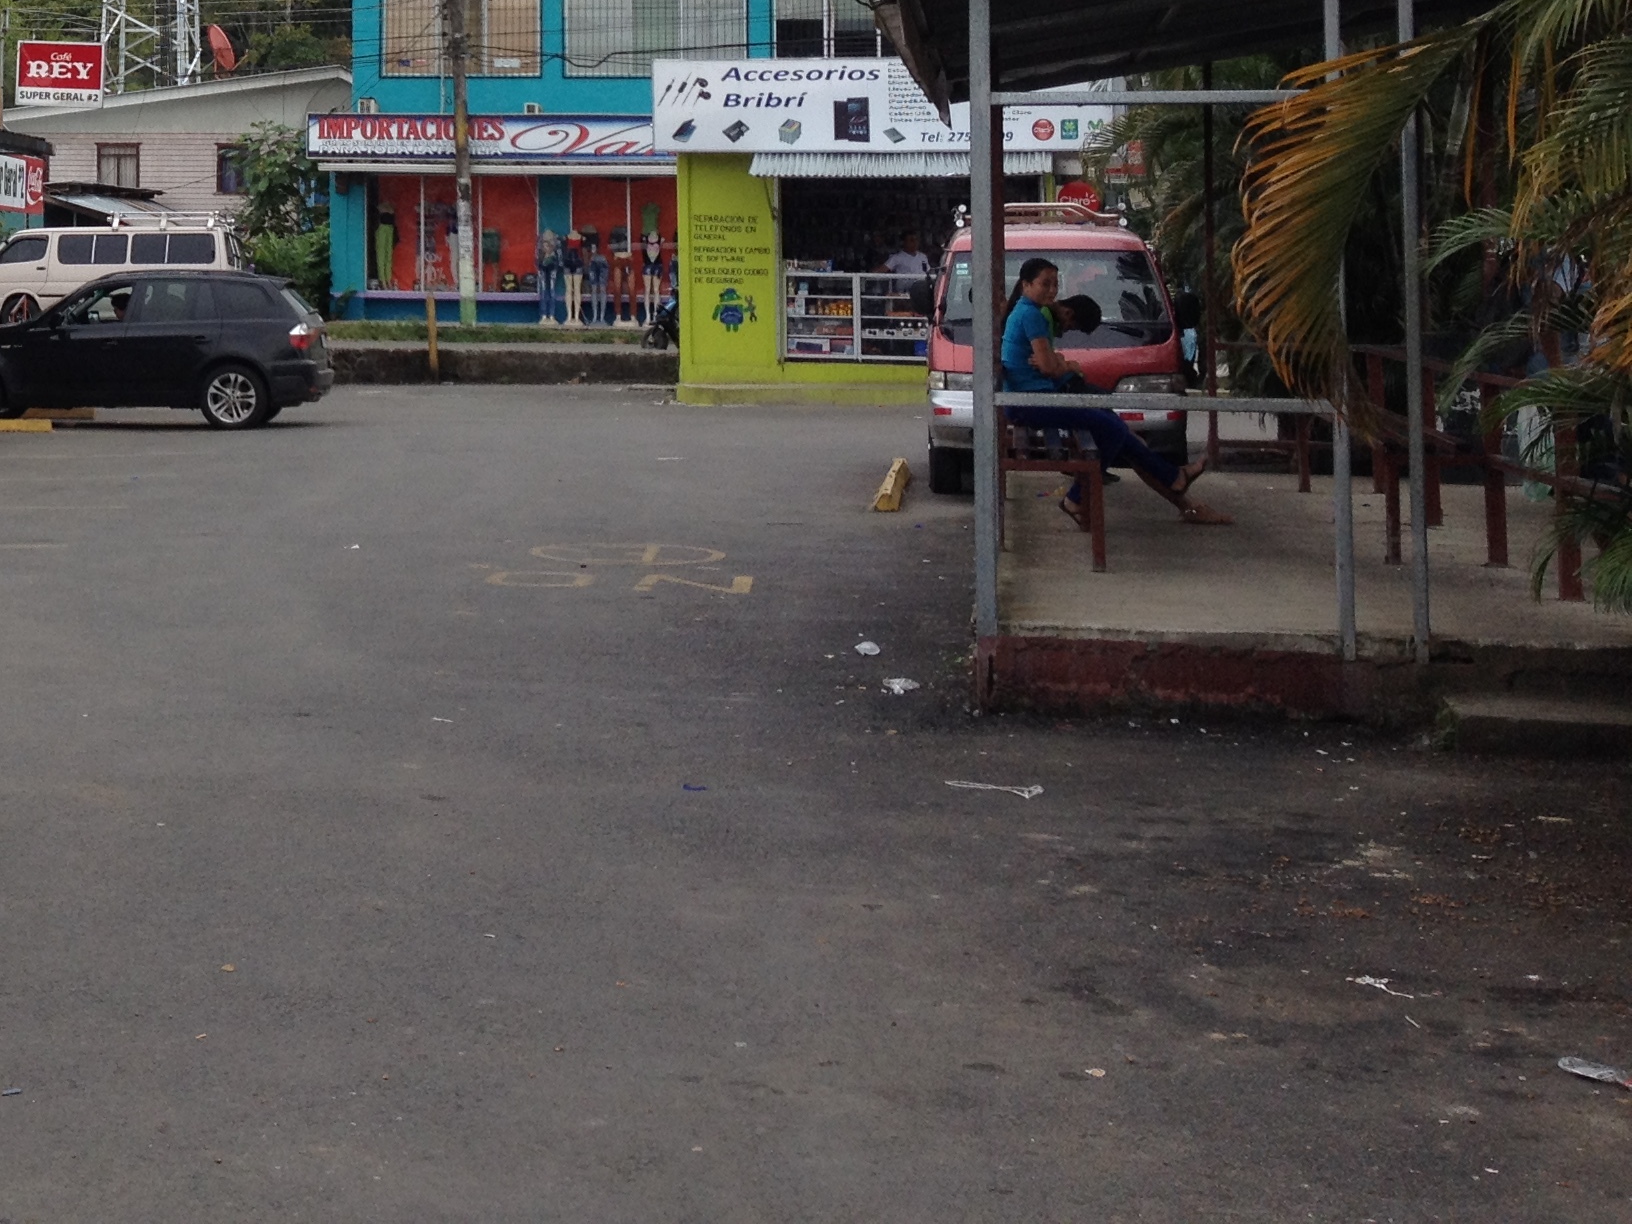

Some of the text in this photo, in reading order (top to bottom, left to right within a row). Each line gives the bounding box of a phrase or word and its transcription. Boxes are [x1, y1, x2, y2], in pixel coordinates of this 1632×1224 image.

[51, 51, 72, 62] Café
[26, 60, 94, 80] REY
[721, 66, 881, 83] Accesorios
[19, 90, 99, 103] SUPER GERAL #2
[722, 91, 808, 109] Bribrí
[920, 131, 943, 143] Tel:
[437, 147, 502, 155] FAILIA
